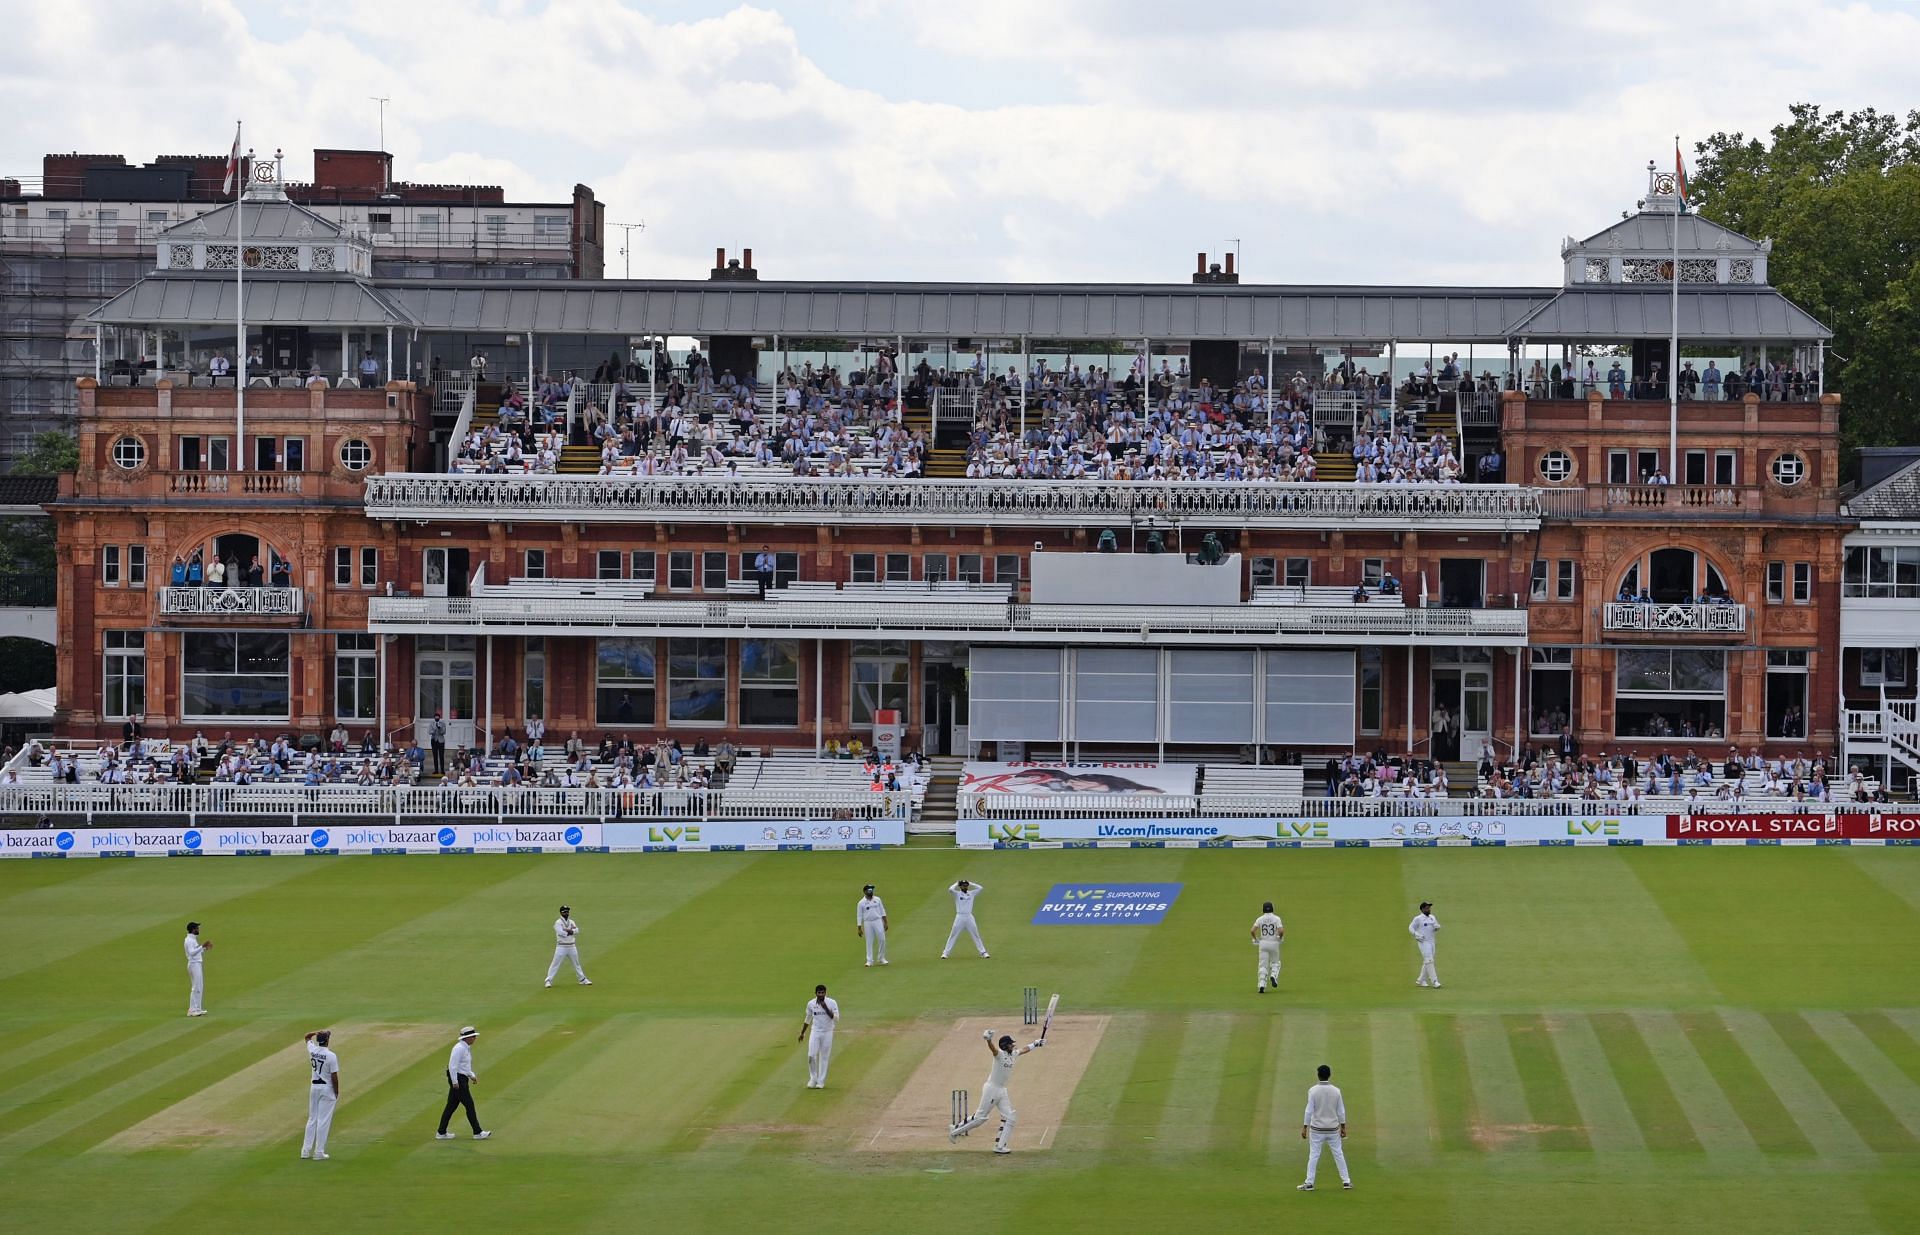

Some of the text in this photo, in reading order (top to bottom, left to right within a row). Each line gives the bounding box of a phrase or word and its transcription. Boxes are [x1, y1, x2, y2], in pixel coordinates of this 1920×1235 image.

[1098, 824, 1219, 838] LV.com/insurance
[1695, 819, 1821, 832] ROYAL STAG
[1106, 891, 1160, 899] SUPPORTING
[1041, 903, 1168, 912] RUTH STRAUSS
[1261, 923, 1275, 936] 63
[310, 1058, 325, 1075] 97
